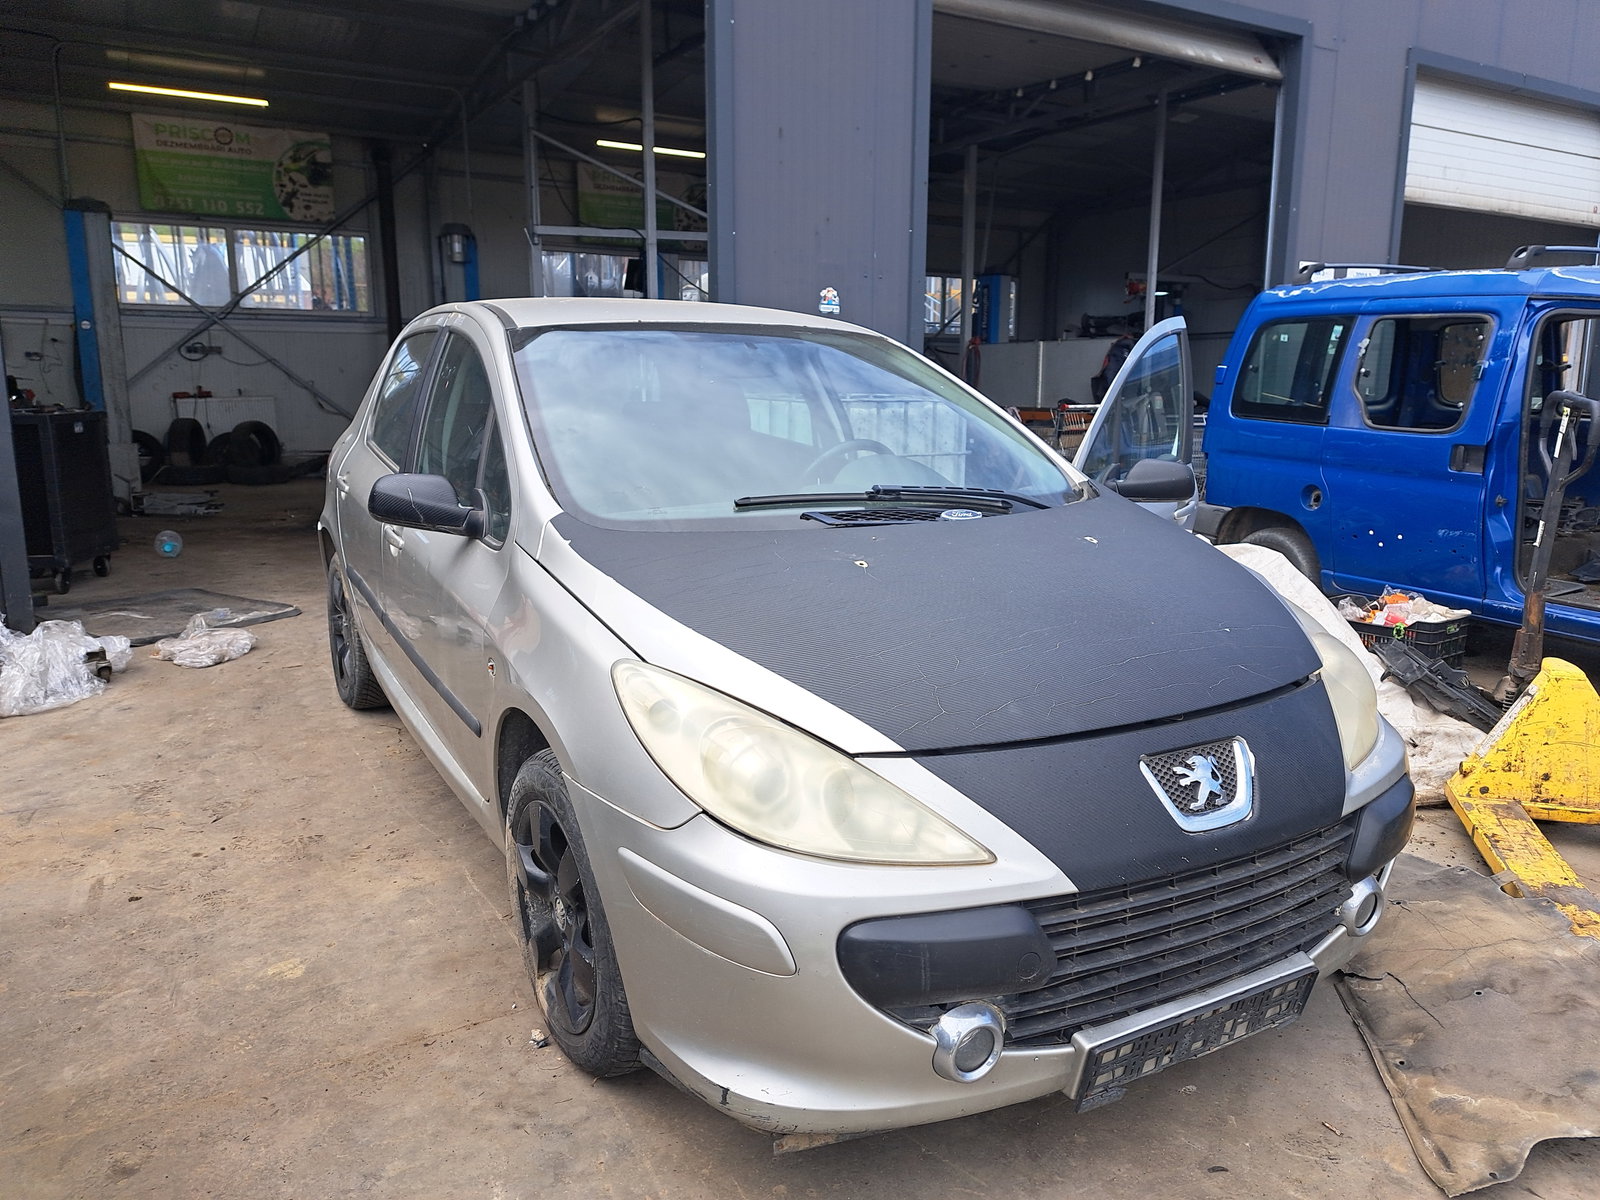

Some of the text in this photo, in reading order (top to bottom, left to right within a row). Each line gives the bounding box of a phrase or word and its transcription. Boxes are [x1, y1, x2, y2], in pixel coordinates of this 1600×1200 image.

[154, 123, 250, 145] PRISCOM
[227, 146, 252, 155] AUTO
[201, 198, 228, 212] 110
[236, 200, 265, 216] 552
